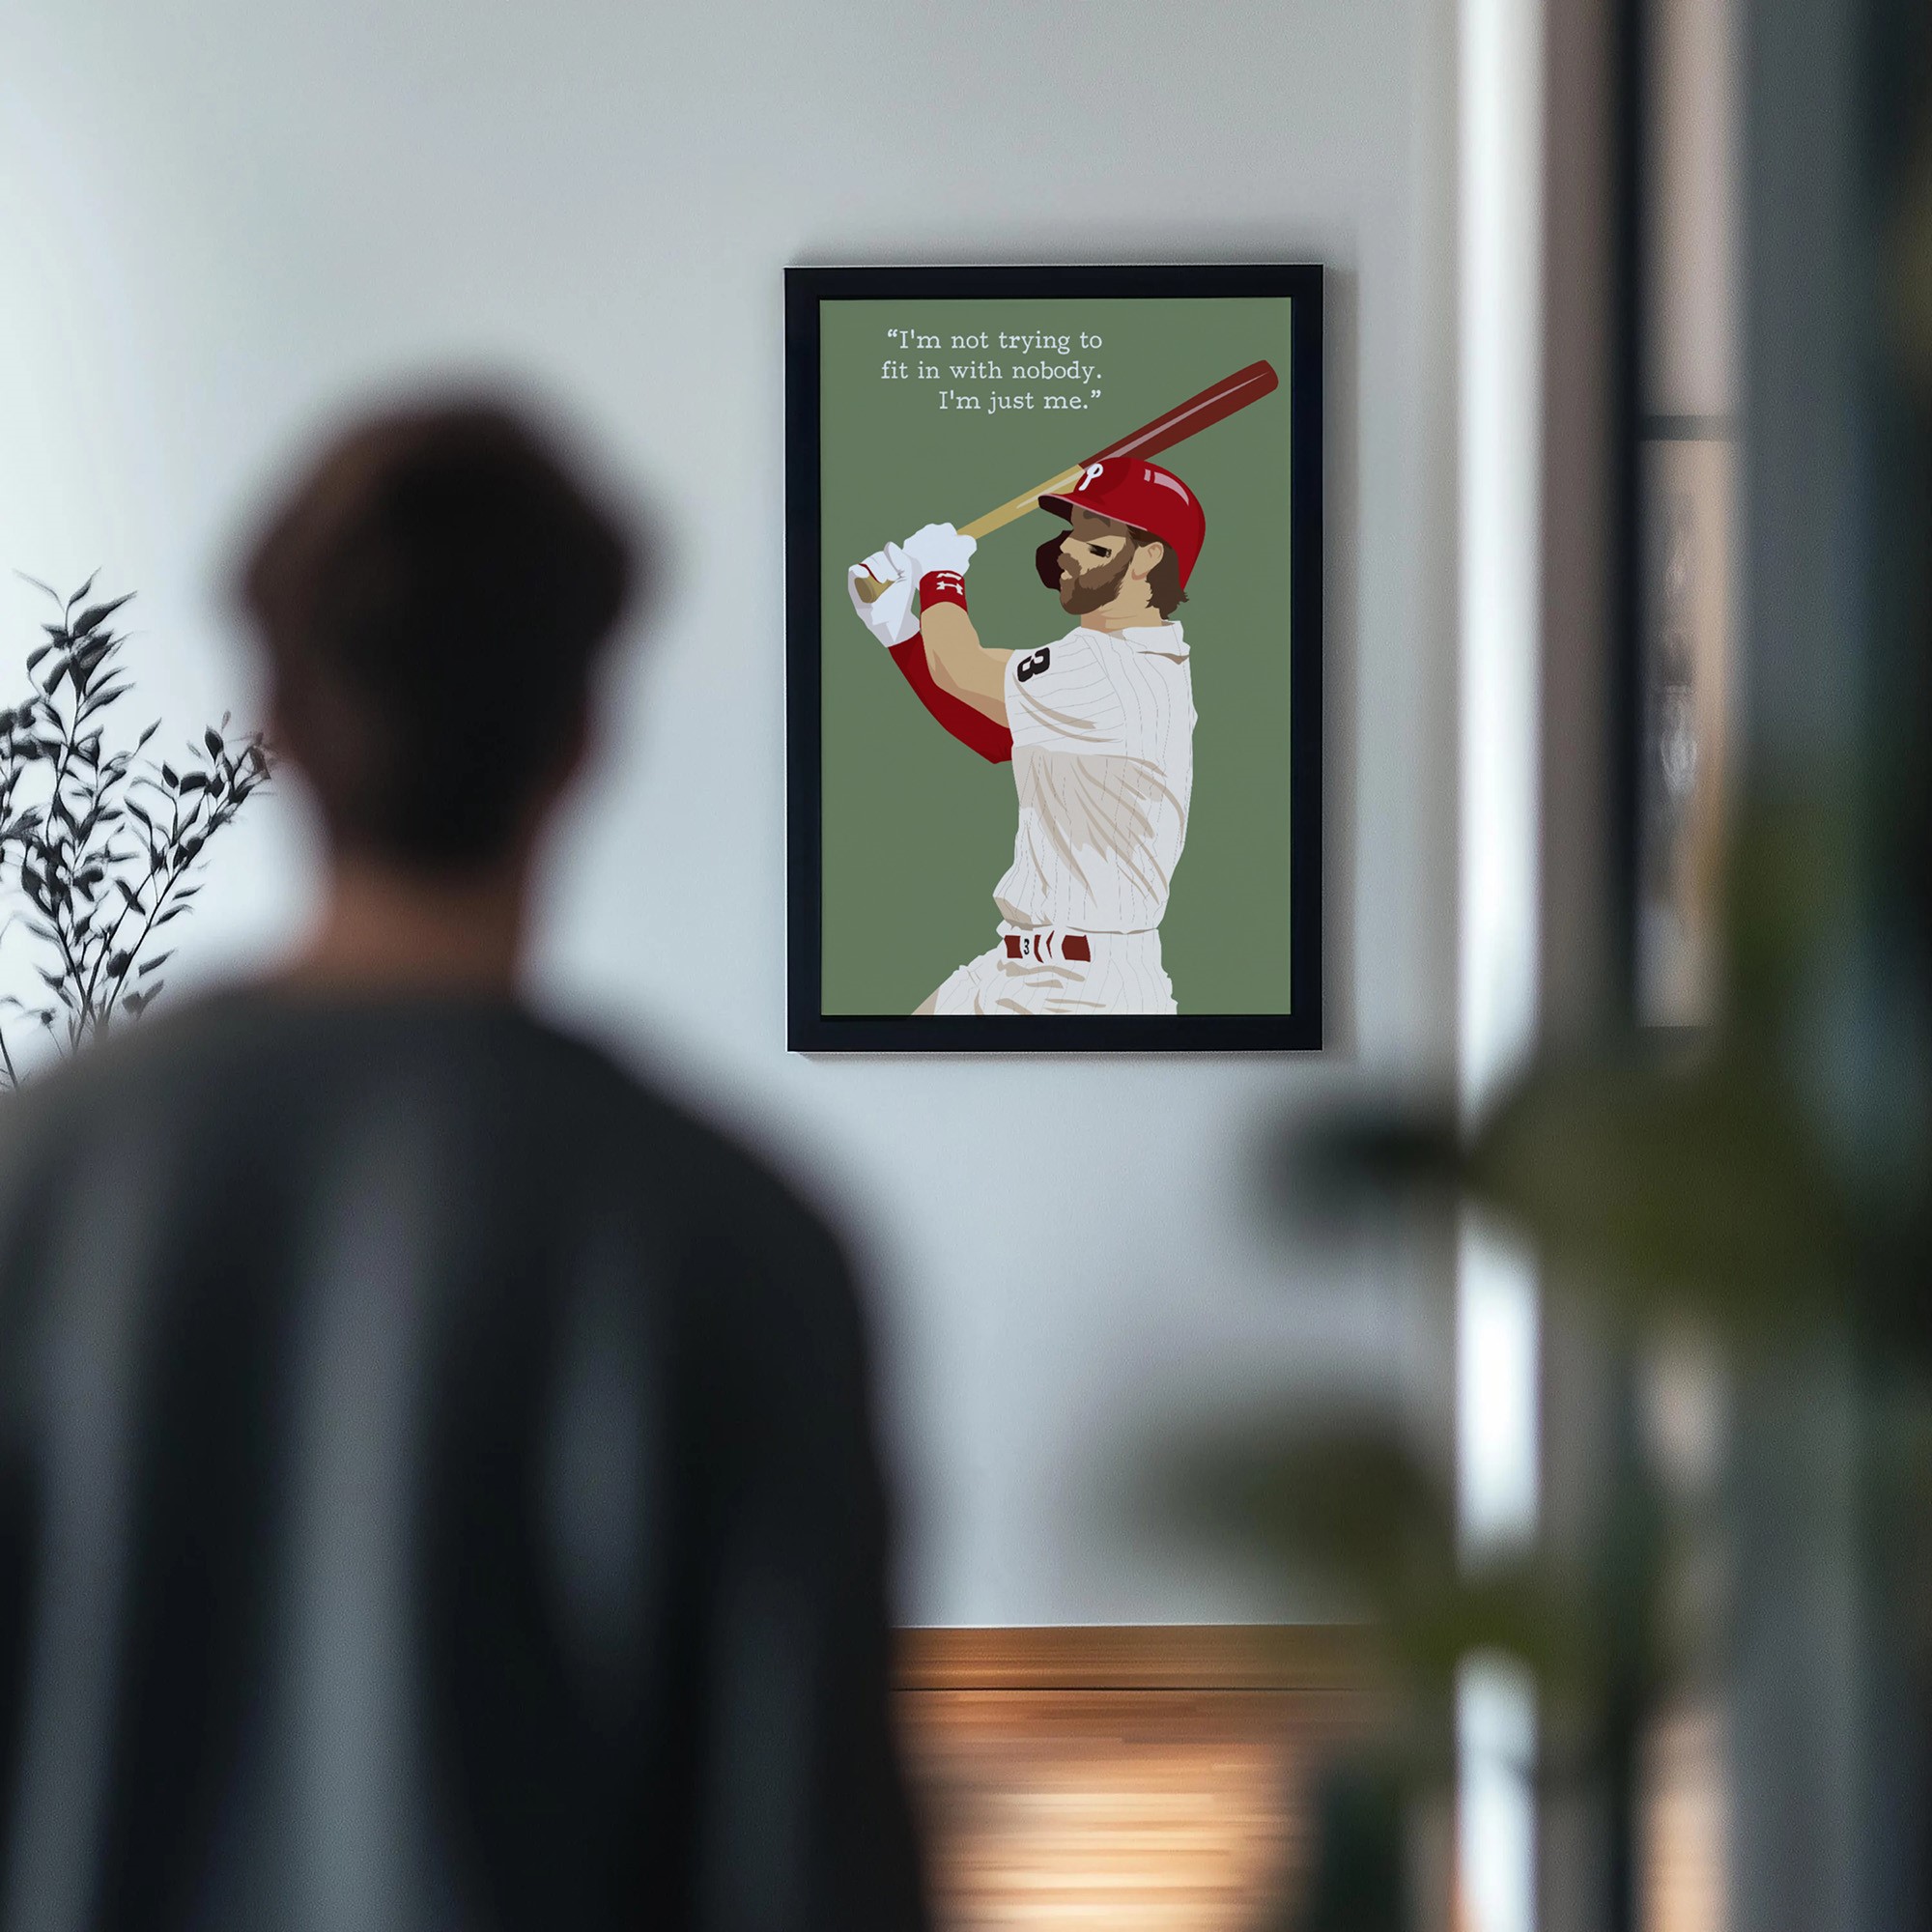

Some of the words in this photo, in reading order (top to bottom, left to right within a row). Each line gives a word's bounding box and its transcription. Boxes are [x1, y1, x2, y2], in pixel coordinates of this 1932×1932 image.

[887, 328, 942, 350] “I'm
[951, 331, 990, 350] not
[998, 329, 1071, 355] trying
[1079, 331, 1103, 350] to
[880, 359, 909, 380] fit
[917, 360, 941, 380] in
[949, 359, 1004, 380] with
[1011, 359, 1102, 384] nobody.
[938, 389, 981, 410] I'm
[987, 390, 1035, 415] just
[1043, 388, 1102, 410] me.”
[1023, 938, 1030, 955] 3
